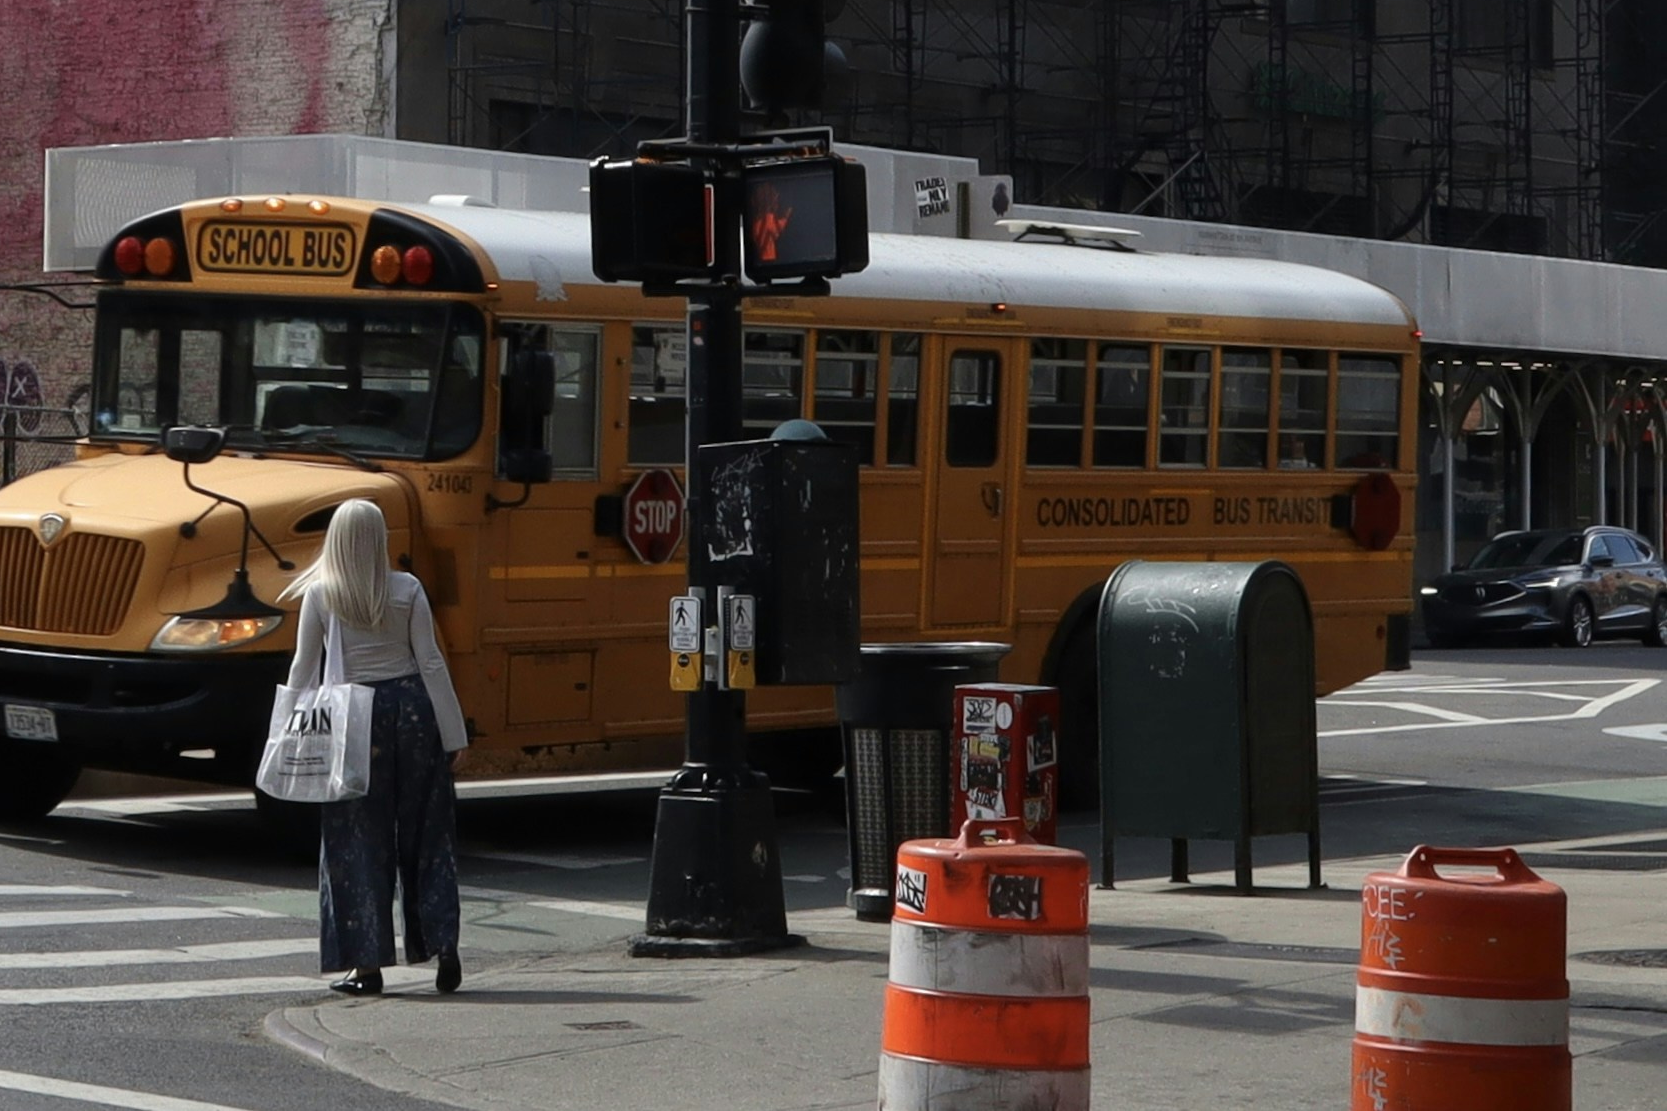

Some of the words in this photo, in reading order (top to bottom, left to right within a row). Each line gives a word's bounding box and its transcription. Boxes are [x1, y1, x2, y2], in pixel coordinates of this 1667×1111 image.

[208, 227, 294, 267] SCHOOL
[302, 230, 347, 269] BUS
[634, 499, 677, 534] STOP
[1036, 495, 1190, 527] CONSOLIDATED
[1212, 496, 1251, 525] BUS
[1256, 495, 1331, 526] TRANSIT
